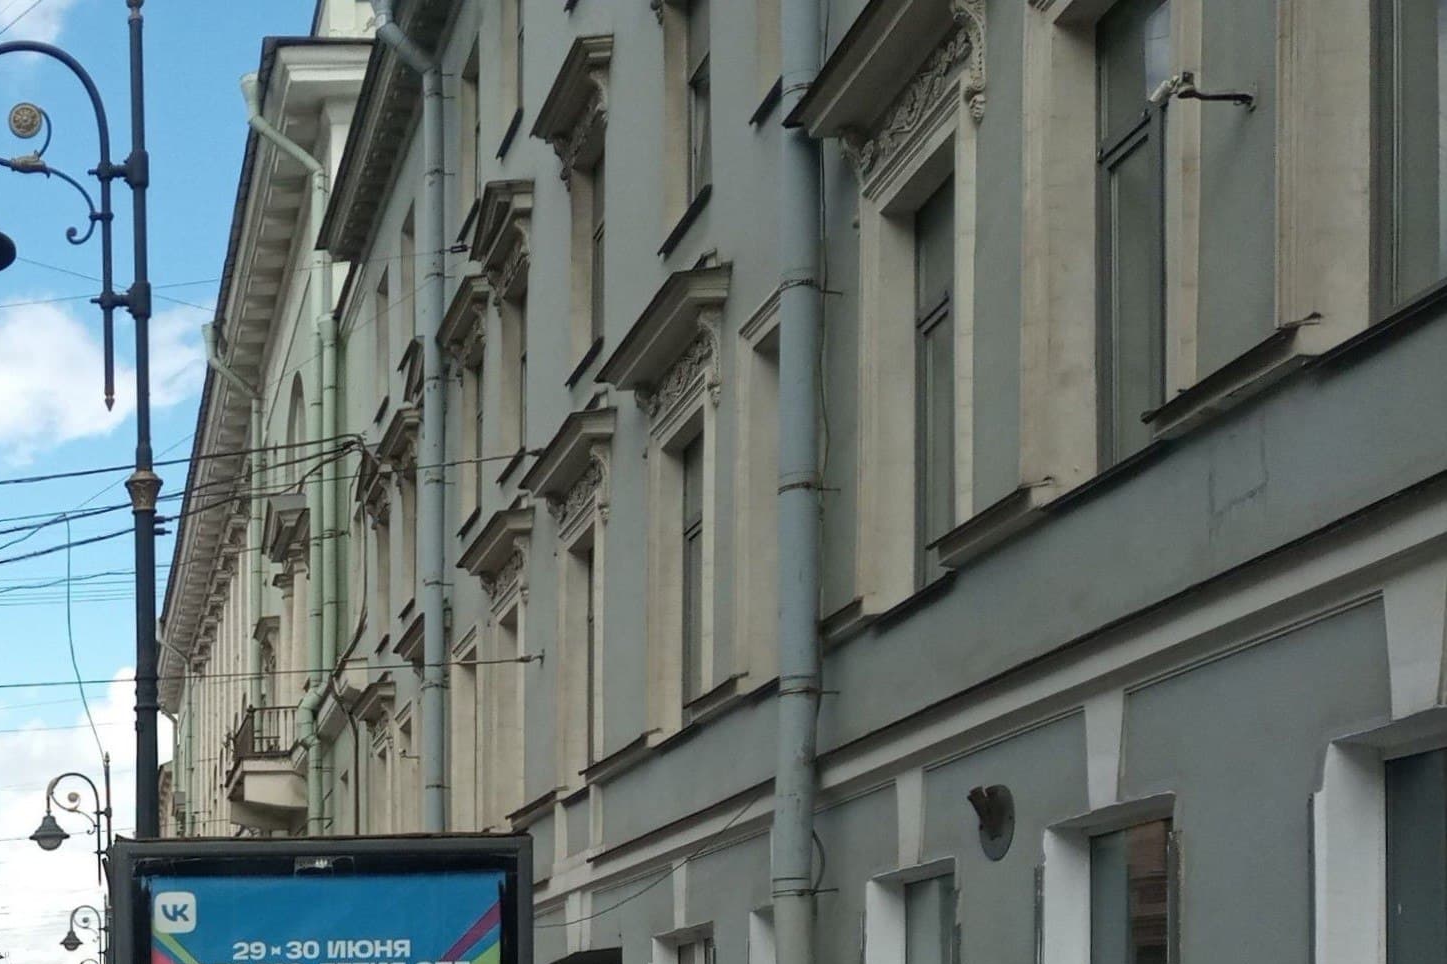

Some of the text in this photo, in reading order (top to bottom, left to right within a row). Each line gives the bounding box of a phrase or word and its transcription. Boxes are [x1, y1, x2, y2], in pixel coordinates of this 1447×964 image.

[160, 903, 190, 922] VK
[232, 939, 411, 961] 29 30 ИЮНЯ
